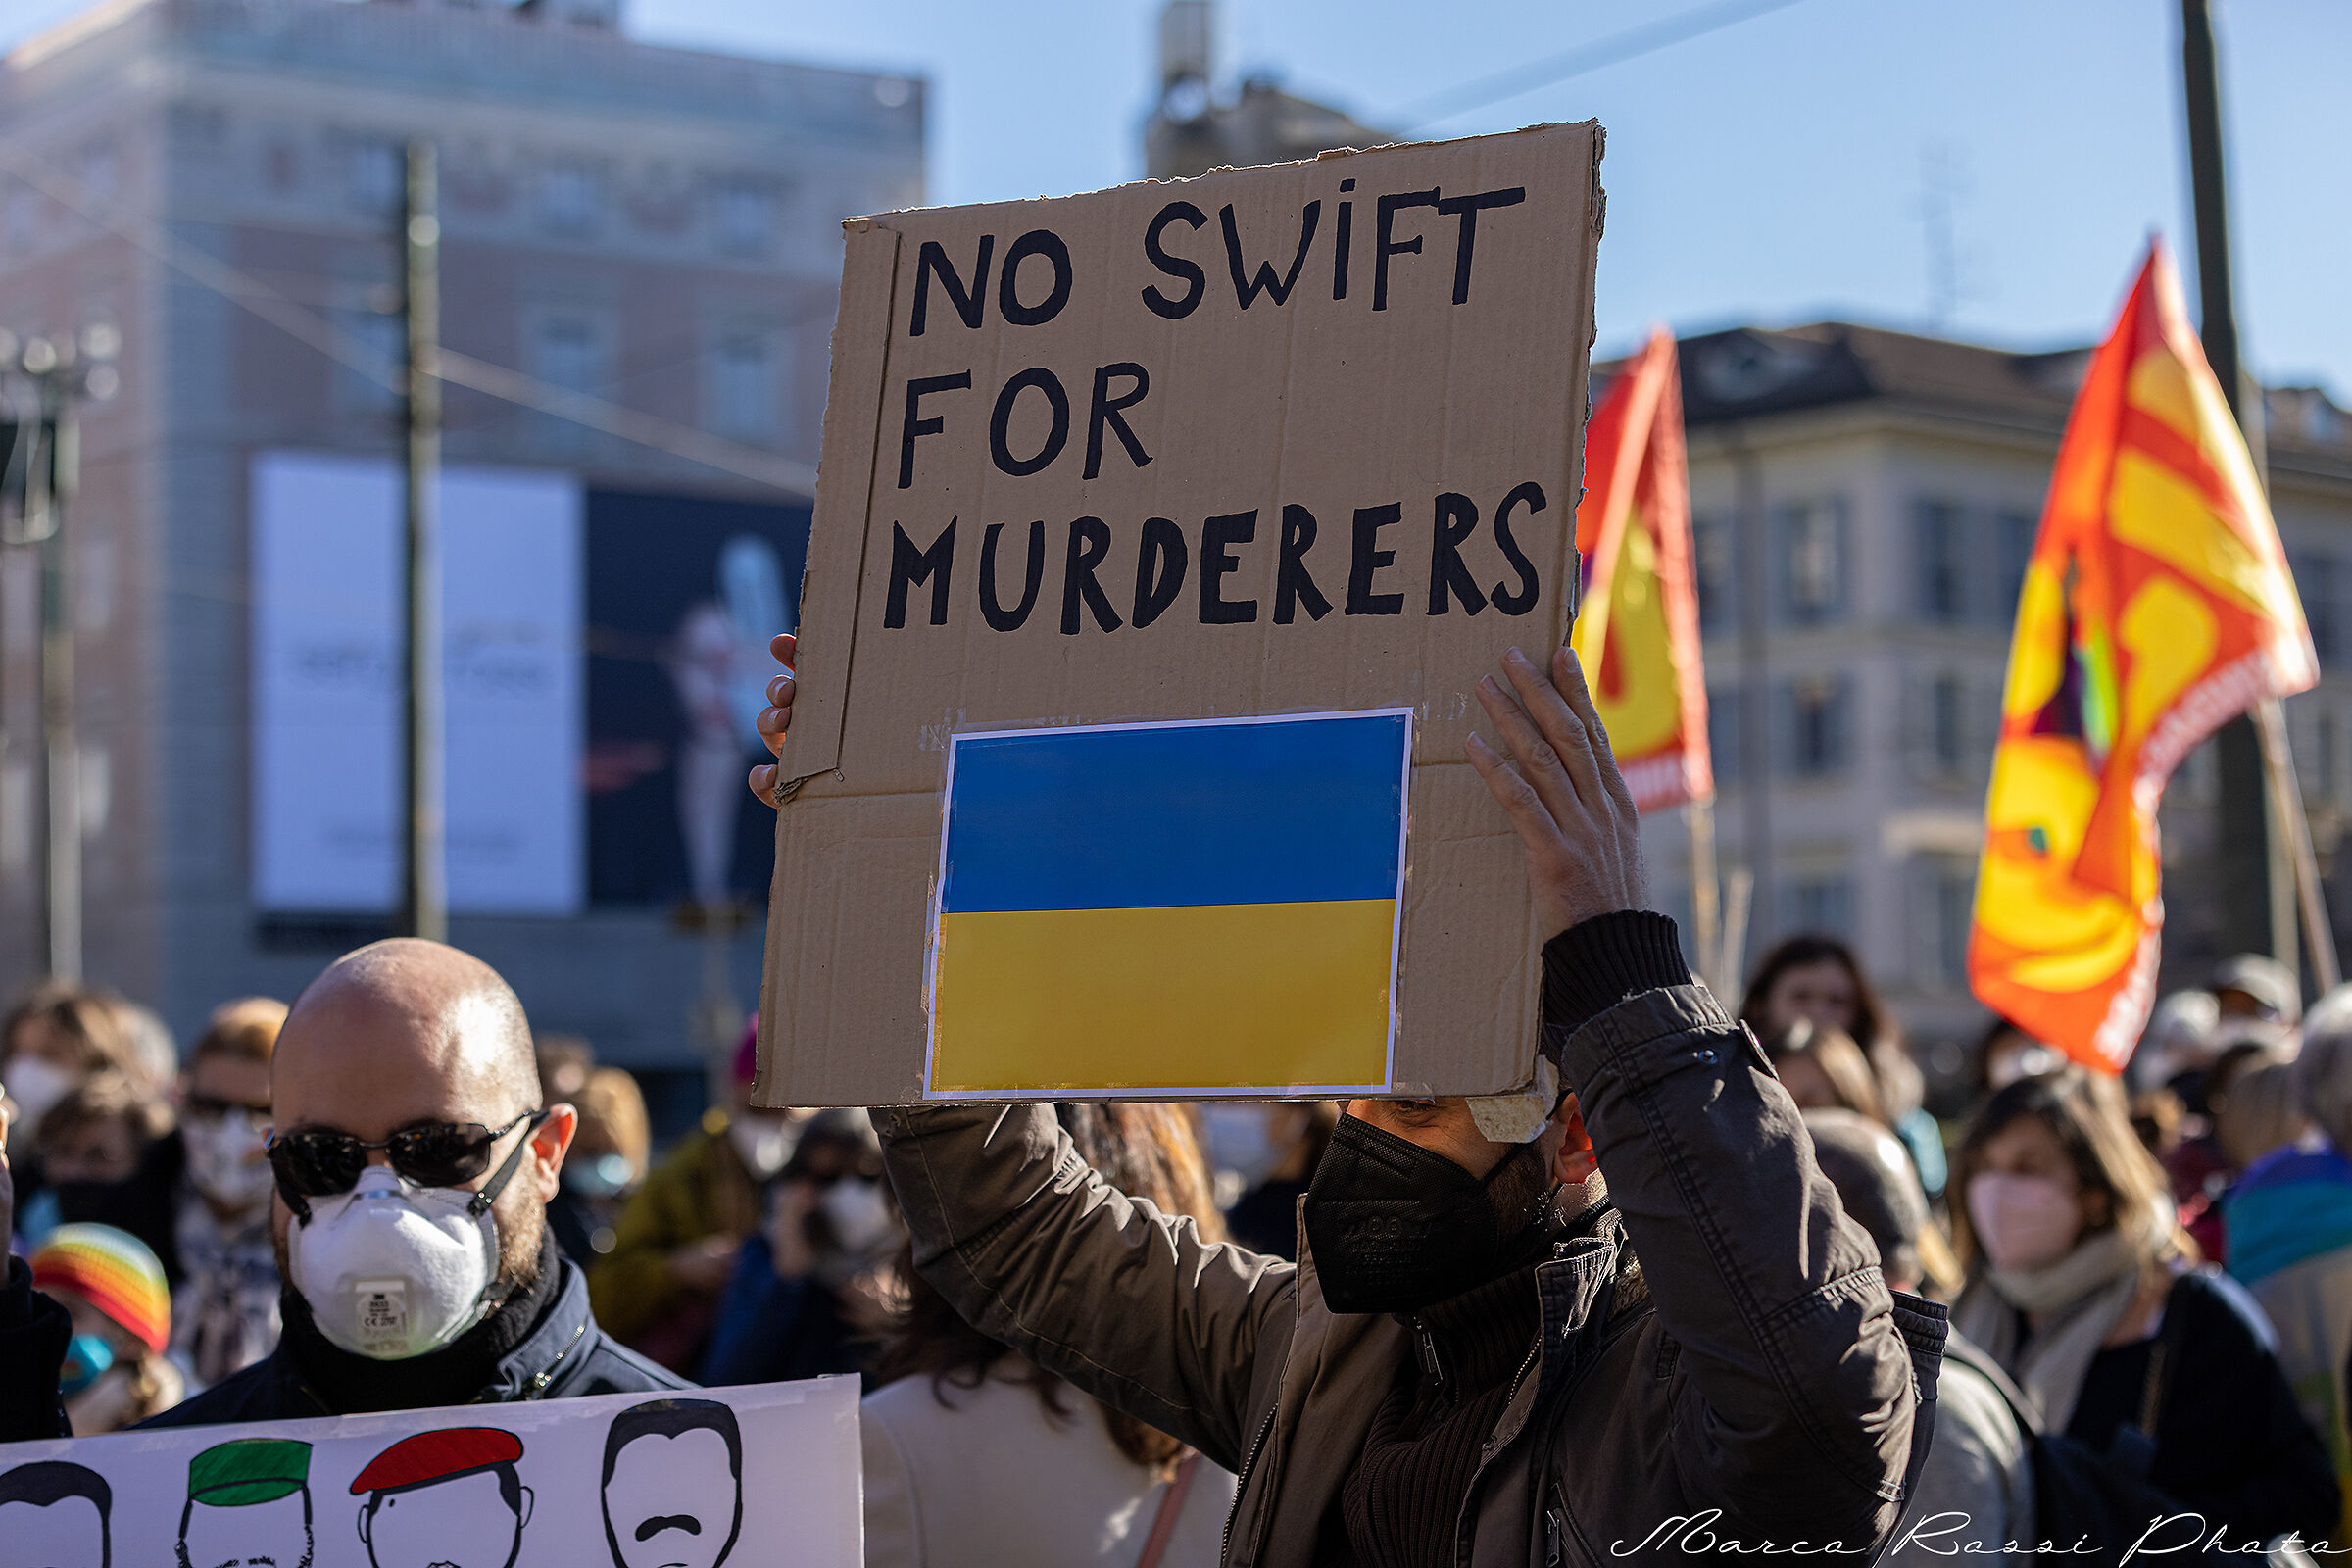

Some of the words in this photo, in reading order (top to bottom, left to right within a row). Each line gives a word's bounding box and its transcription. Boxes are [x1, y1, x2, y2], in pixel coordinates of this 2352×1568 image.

[909, 228, 1073, 337] NO
[897, 362, 1154, 490] FOR
[883, 480, 1548, 636] MURDERERS
